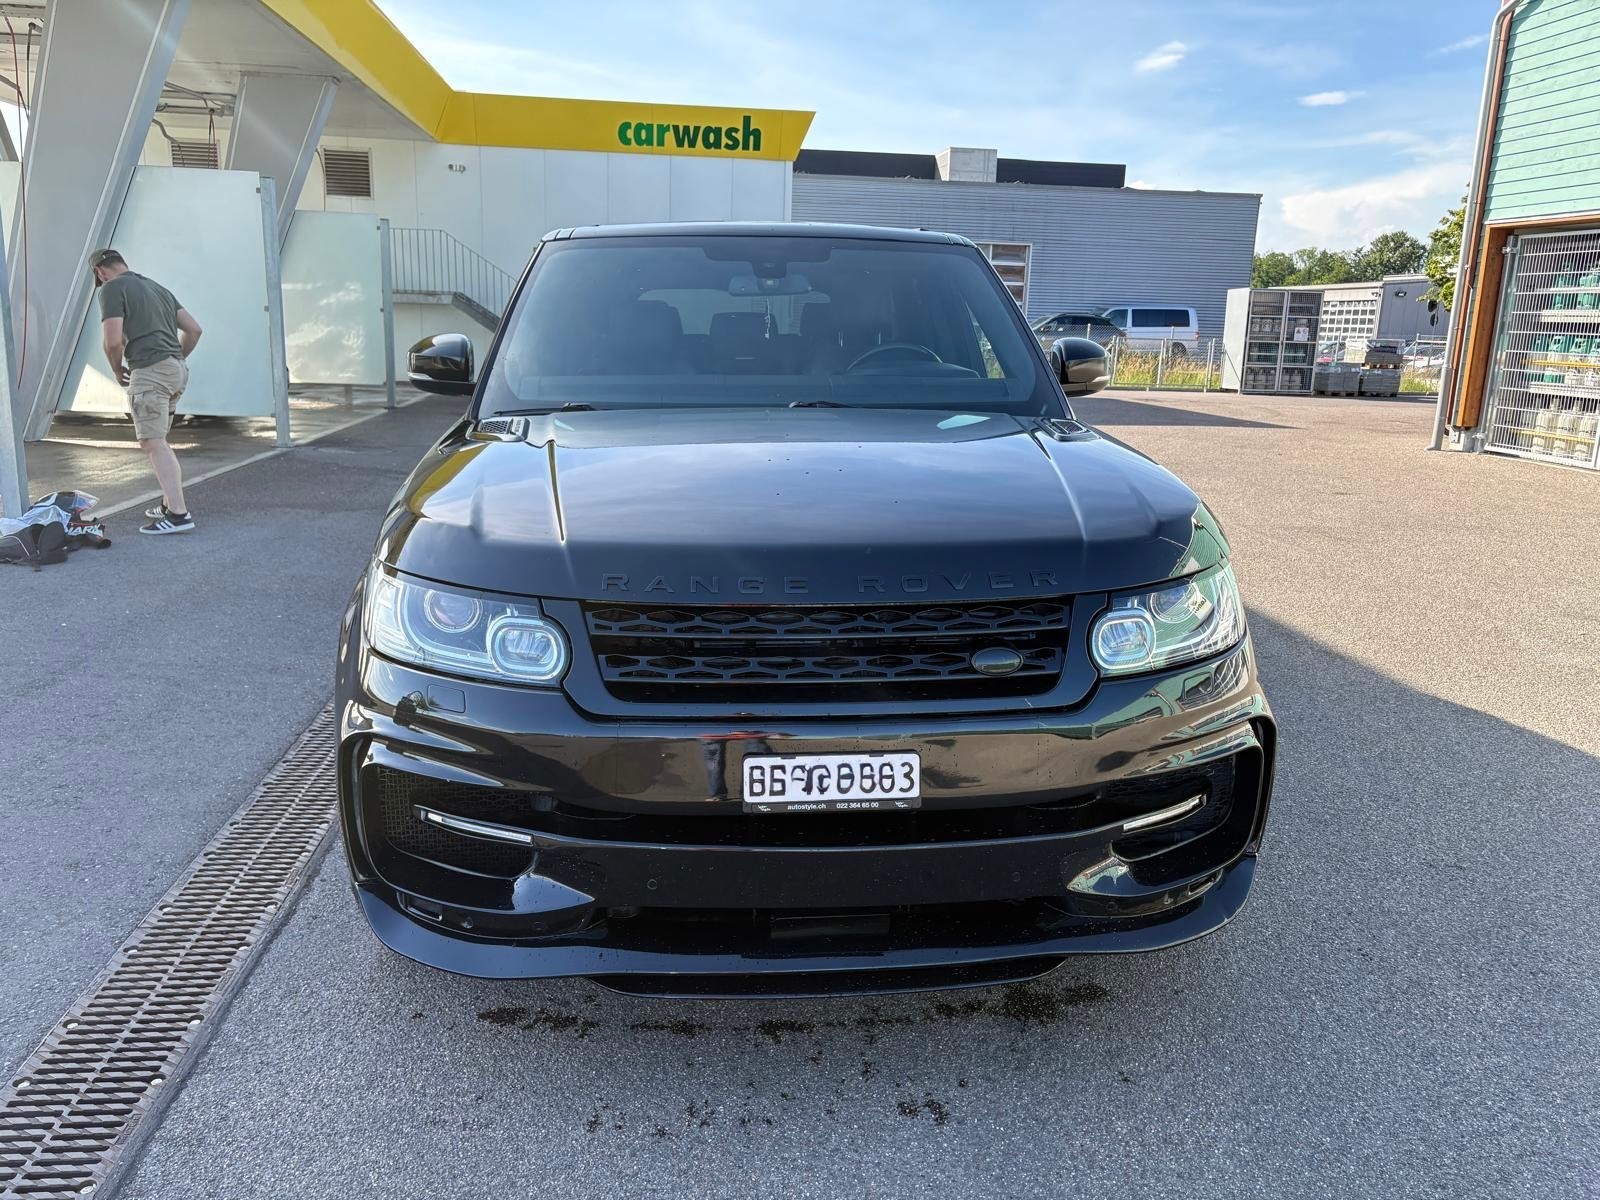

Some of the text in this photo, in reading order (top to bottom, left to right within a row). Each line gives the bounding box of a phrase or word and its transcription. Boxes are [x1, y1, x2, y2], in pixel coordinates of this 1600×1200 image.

[618, 116, 762, 151] carwash
[601, 569, 1060, 594] RANGE ROVER
[787, 803, 827, 811] autostyle.ch
